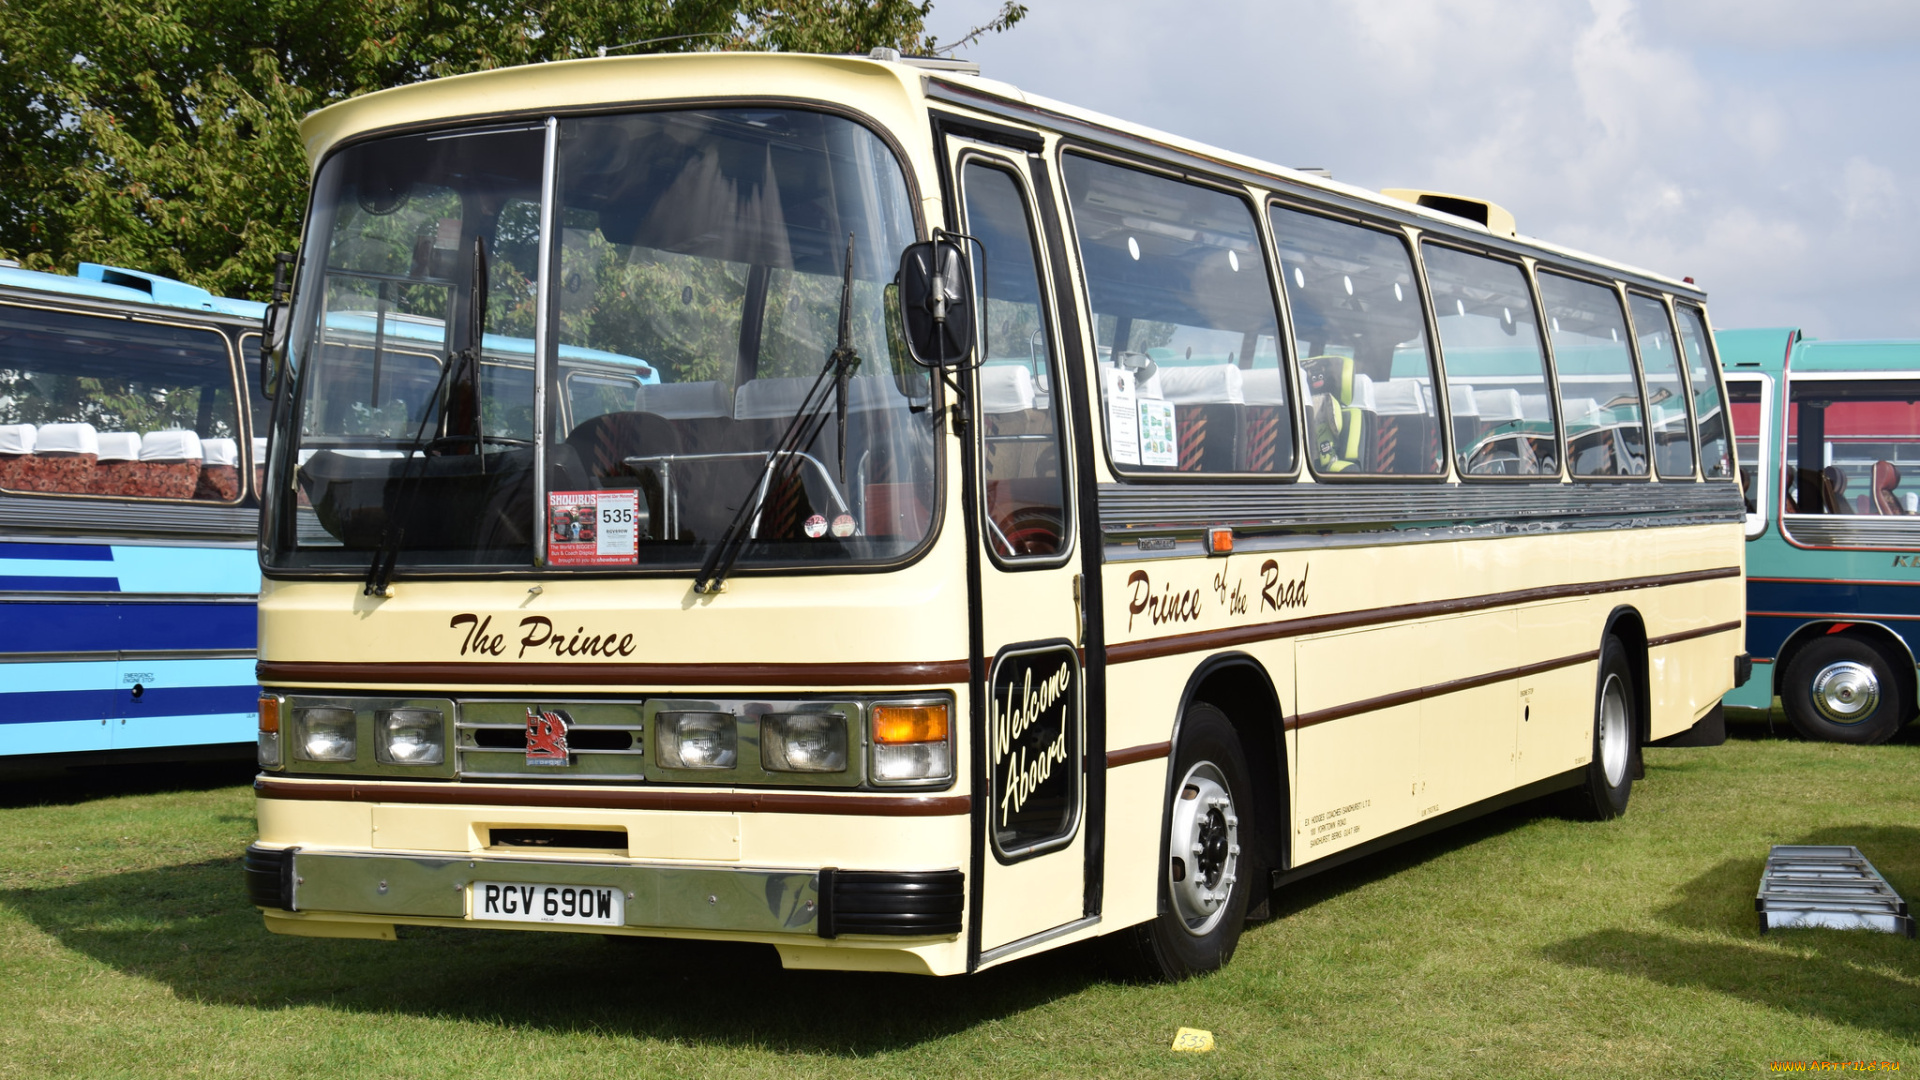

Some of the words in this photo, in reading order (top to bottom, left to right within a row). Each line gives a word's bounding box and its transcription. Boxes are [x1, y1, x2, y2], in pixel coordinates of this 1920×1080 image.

[550, 494, 596, 505] SHOWBUS
[603, 509, 632, 523] 535
[1127, 569, 1202, 633] Prince
[1214, 557, 1228, 605] of
[1229, 578, 1248, 616] the
[1260, 559, 1309, 613] Road
[450, 613, 506, 656] The
[518, 615, 637, 659] Prince
[994, 662, 1070, 764] Welcome
[1002, 704, 1068, 827] Aboard
[485, 884, 535, 914] RGV
[544, 887, 612, 919] 690W
[1178, 1033, 1207, 1048] 535
